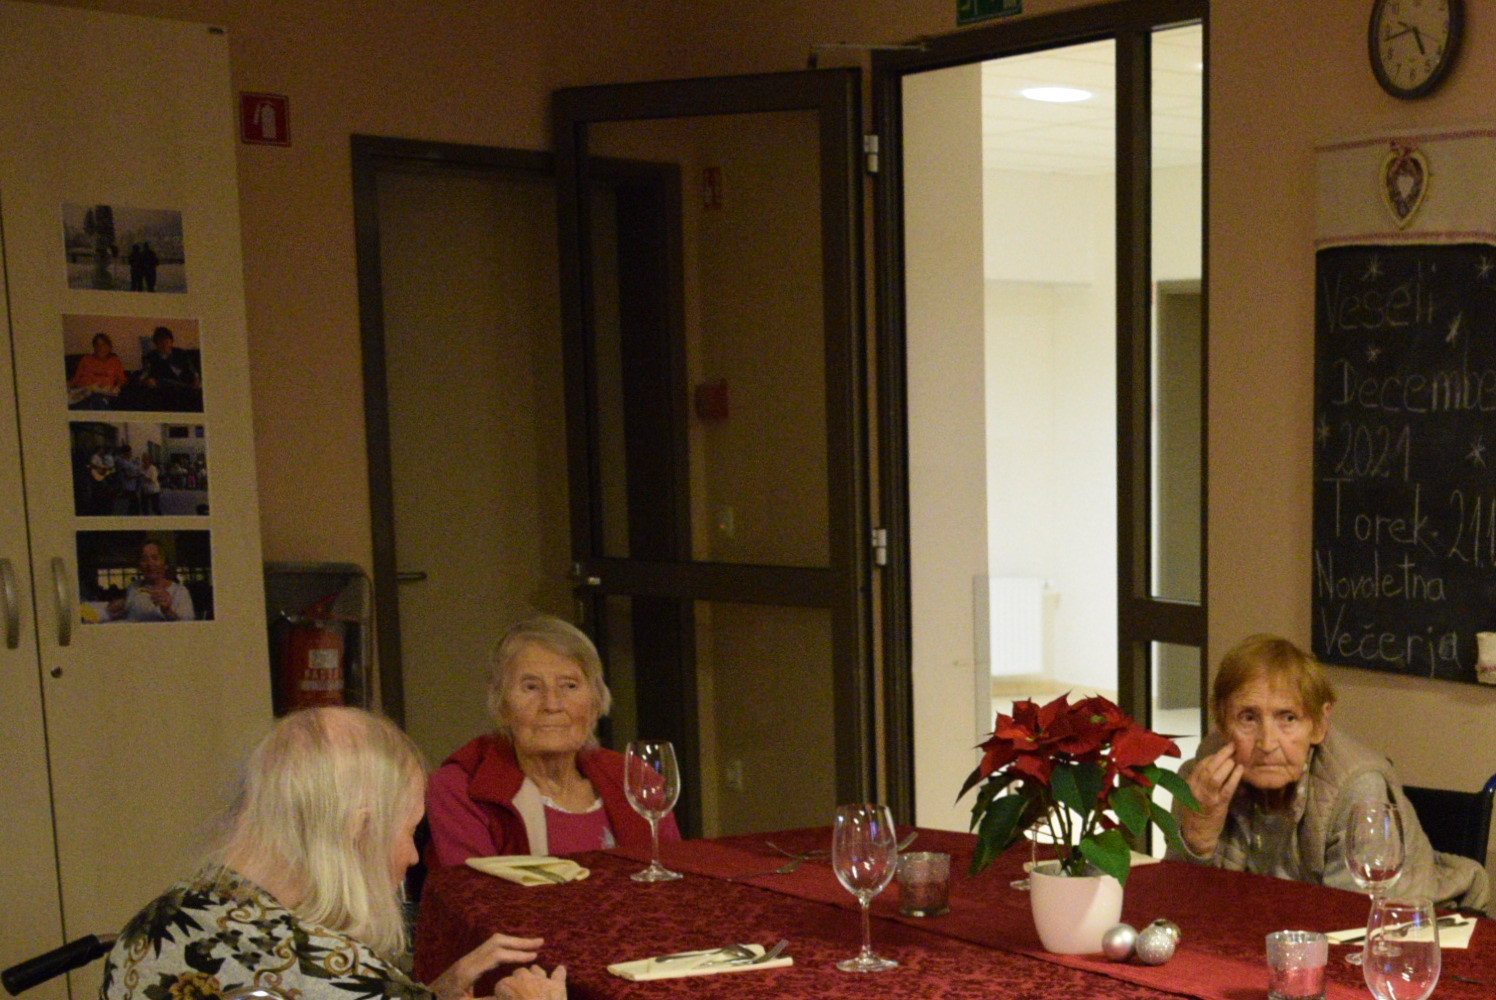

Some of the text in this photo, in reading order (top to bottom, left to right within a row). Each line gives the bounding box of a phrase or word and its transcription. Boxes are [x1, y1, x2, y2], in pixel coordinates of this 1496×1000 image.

[1323, 260, 1437, 334] Veseli
[1322, 478, 1432, 552] Torek
[1321, 603, 1462, 678] Večerja
